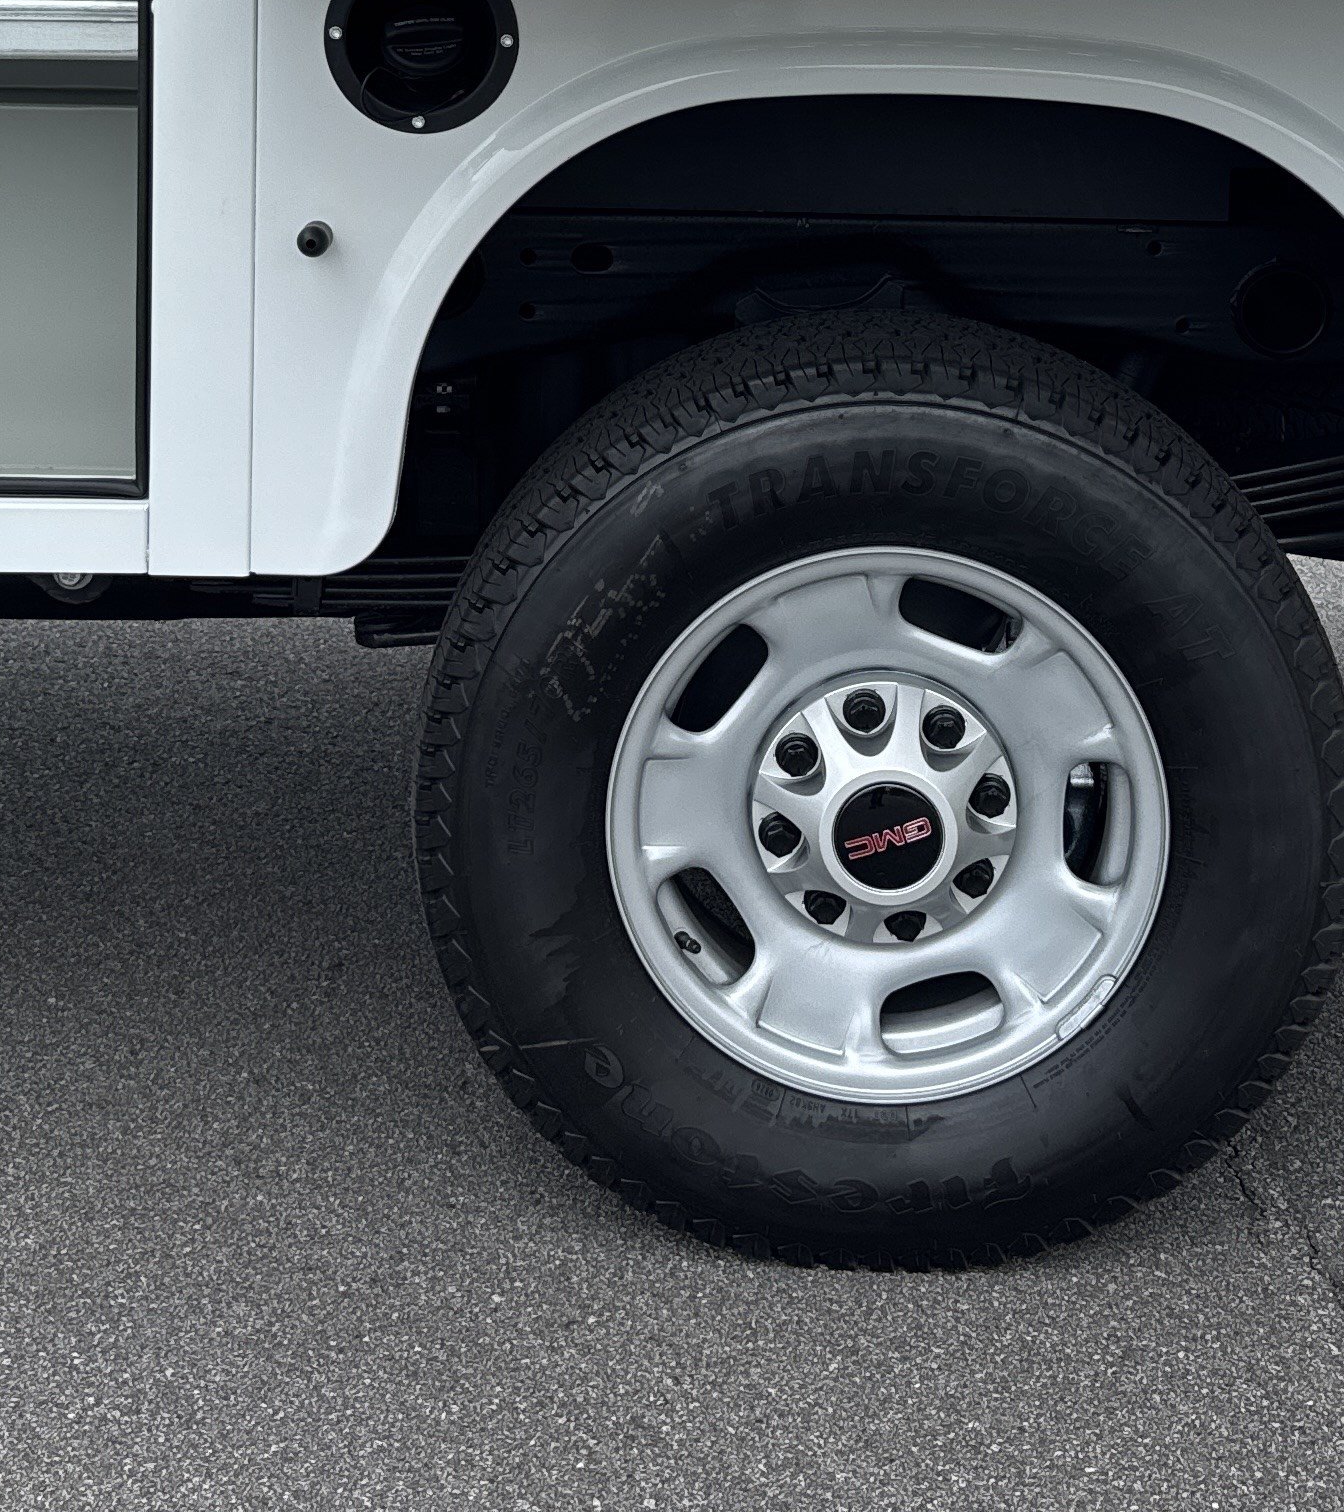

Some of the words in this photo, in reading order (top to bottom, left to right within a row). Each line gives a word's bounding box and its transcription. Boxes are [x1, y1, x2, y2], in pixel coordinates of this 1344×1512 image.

[705, 449, 1153, 582] TRANSFORCE
[1144, 593, 1236, 661] AT
[844, 816, 932, 860] GMC
[584, 1044, 1031, 1212] Firestone
